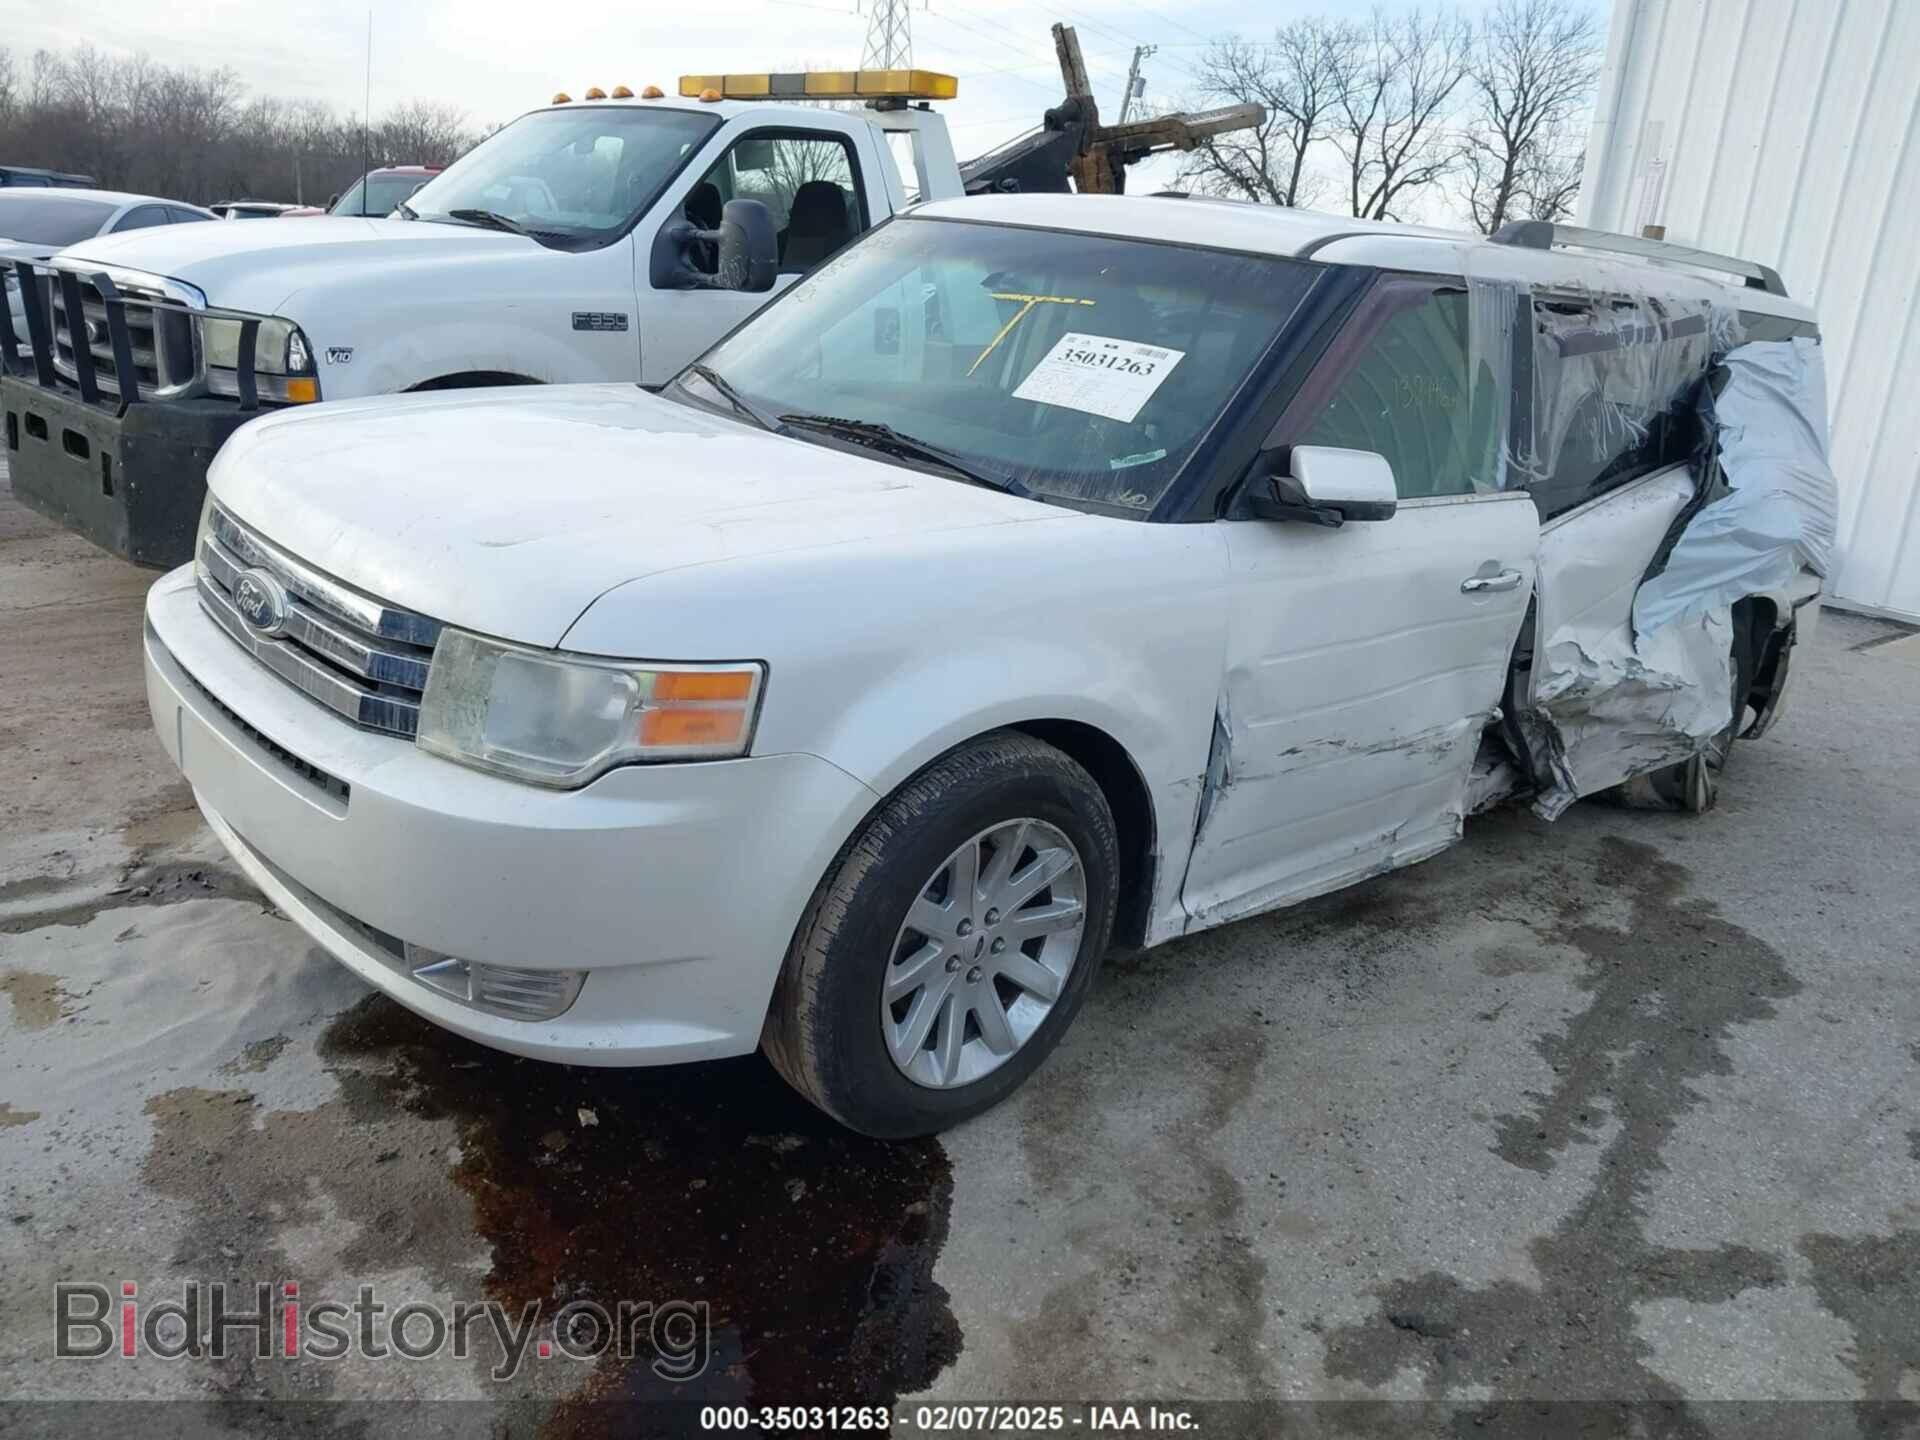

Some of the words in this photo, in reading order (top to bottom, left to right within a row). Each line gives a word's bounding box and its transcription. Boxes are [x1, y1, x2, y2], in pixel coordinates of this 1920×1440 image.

[325, 351, 352, 365] V10
[1057, 347, 1156, 377] 35031263
[236, 579, 266, 619] Ford
